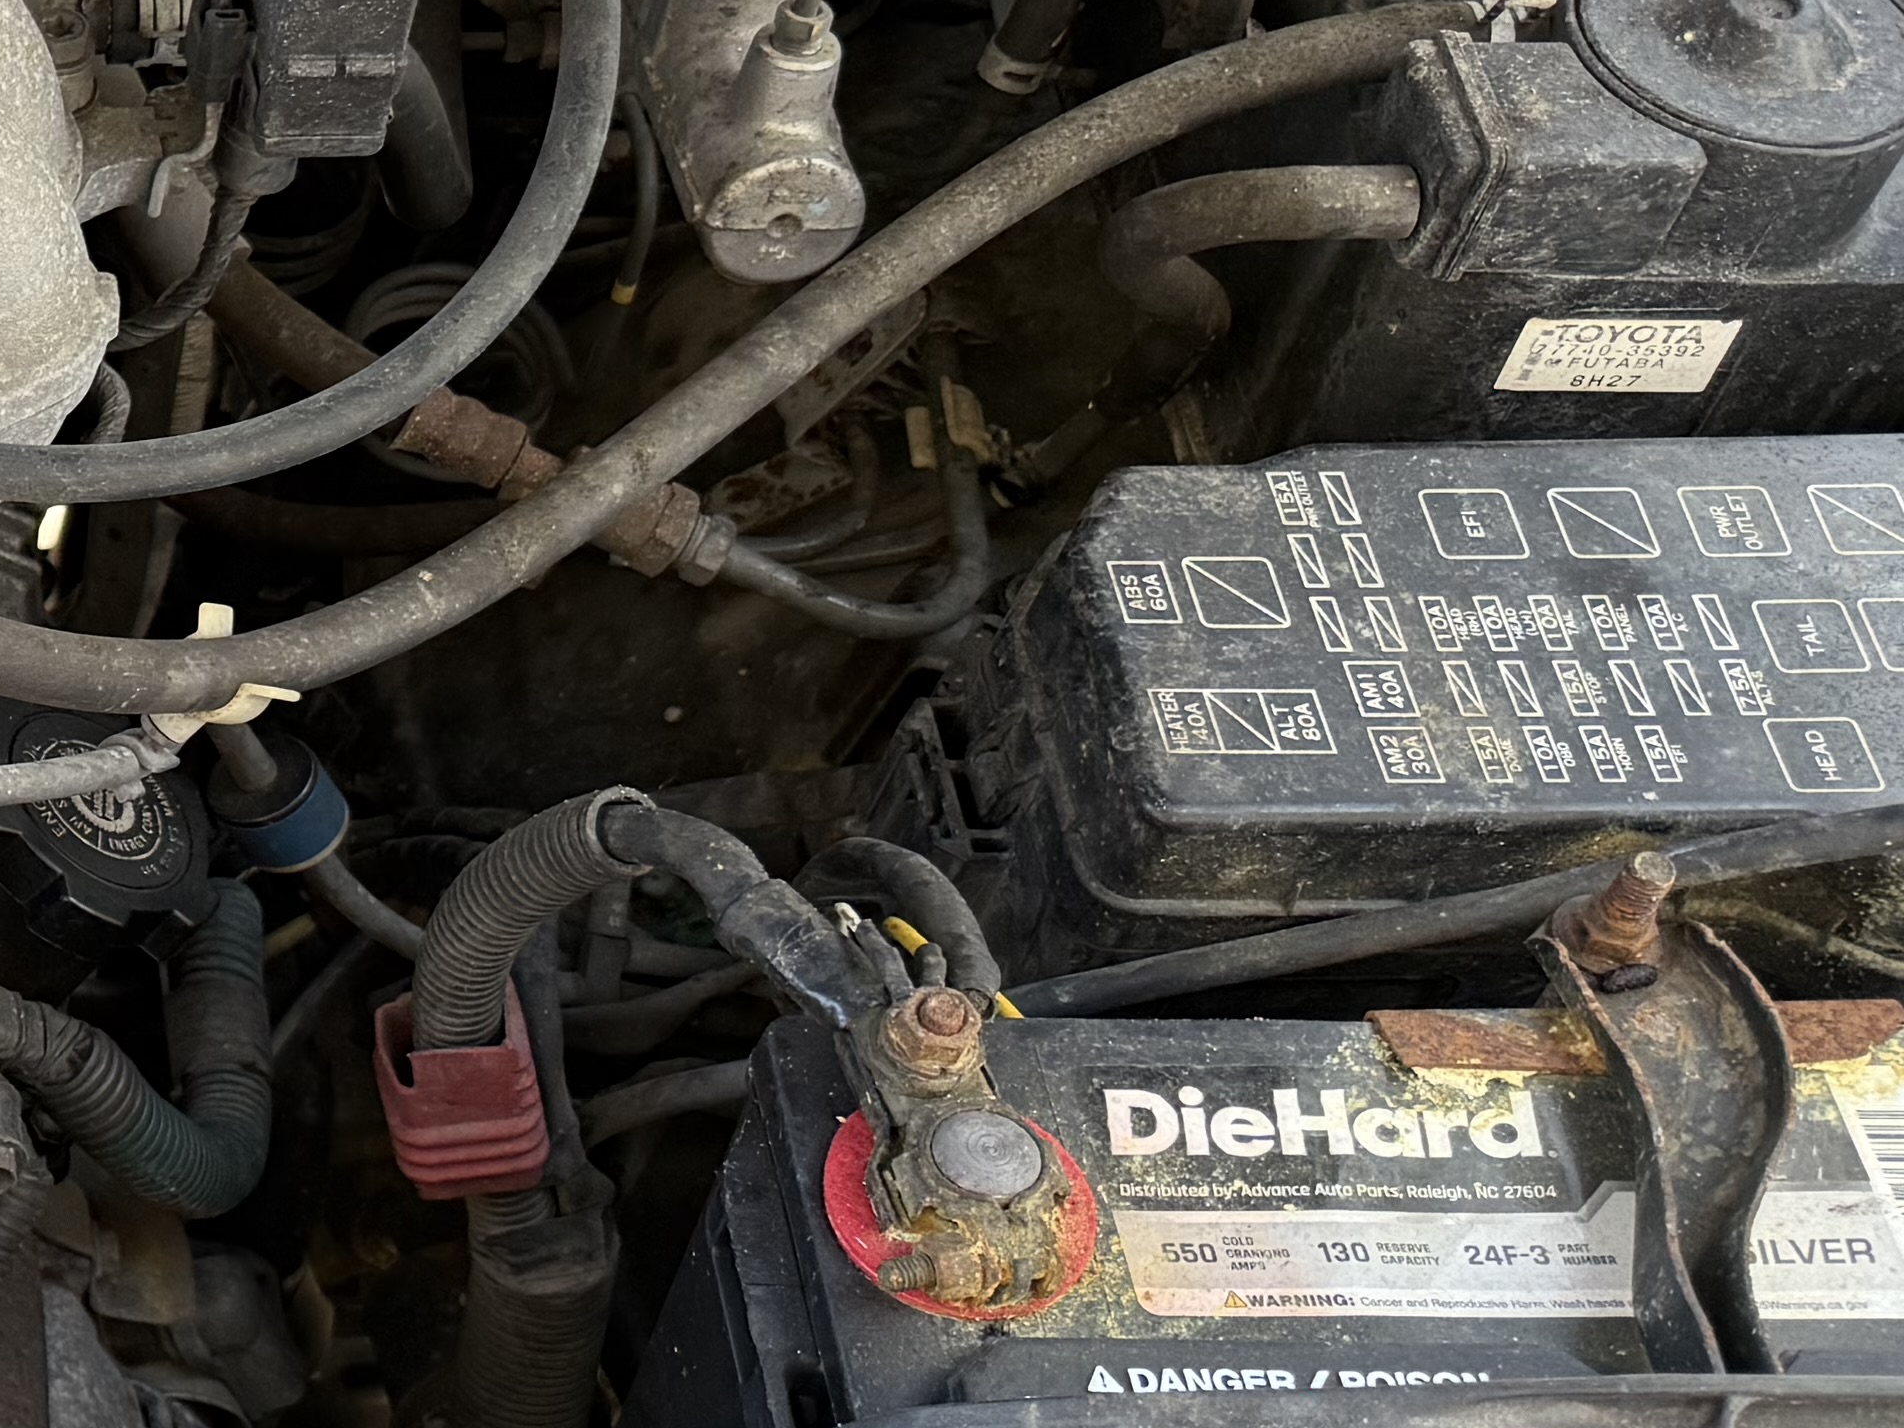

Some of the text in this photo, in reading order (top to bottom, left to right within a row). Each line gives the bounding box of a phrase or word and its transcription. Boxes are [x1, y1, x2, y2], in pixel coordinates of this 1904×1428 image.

[1554, 324, 1703, 345] TOYOTA
[1567, 357, 1664, 369] FUTABA
[1274, 481, 1298, 514] 15A
[1460, 511, 1486, 538] EFI
[1710, 506, 1737, 538] PWR
[1725, 493, 1764, 551] OUTLET
[1120, 574, 1147, 611] ABS
[1142, 574, 1168, 611] 60A
[1428, 605, 1452, 641] 10A
[1450, 608, 1470, 641] HEAD
[1482, 604, 1507, 640] 10A
[1505, 607, 1526, 640] HEAD
[1538, 604, 1562, 640] 10A
[1562, 609, 1580, 635] TAIL
[1593, 603, 1617, 640] 10A
[1615, 604, 1638, 642] PANEL
[1648, 603, 1672, 638] 10A
[1796, 614, 1825, 657] TAIL
[1357, 673, 1385, 710] AM1
[1378, 670, 1405, 709] 40A
[1562, 669, 1587, 705] 15A
[1585, 673, 1607, 704] STOP
[1728, 666, 1757, 709] 7.5A
[1157, 691, 1188, 752] HEATER
[1187, 703, 1209, 742] 40A
[1270, 703, 1299, 740] ALT
[1294, 703, 1321, 741] 80A
[1380, 735, 1409, 775] AM2
[1403, 736, 1431, 774] 30A
[1476, 735, 1499, 772] 15A
[1532, 734, 1557, 772] 10A
[1588, 734, 1614, 771] 15A
[1611, 737, 1634, 771] HORN
[1644, 735, 1671, 771] 15A
[1670, 744, 1688, 764] EFI
[1805, 730, 1842, 781] HEAD
[1103, 1086, 1544, 1159] DieHard
[1120, 1183, 1209, 1198] Distributed
[1241, 1182, 1310, 1198] Advance
[1314, 1183, 1353, 1198] Auto
[1357, 1183, 1404, 1200] Parts,
[1406, 1183, 1472, 1202] Raleigh,
[1476, 1183, 1500, 1199] NC
[1504, 1184, 1558, 1199] 27604
[1161, 1242, 1370, 1264] 550 130
[1222, 1236, 1254, 1247] COLD
[1225, 1248, 1291, 1260] CRANKING
[1376, 1242, 1431, 1254] RESERVE
[1464, 1244, 1552, 1266] 24F-3
[1557, 1243, 1592, 1254] PART
[1230, 1260, 1266, 1271] AMPS
[1380, 1255, 1441, 1266] CAPACITY
[1563, 1255, 1618, 1266] NUMBER
[1246, 1294, 1355, 1308] WARNING:
[1360, 1296, 1403, 1308] Cancer
[1406, 1297, 1429, 1308] and
[1549, 1299, 1585, 1309] Wash
[1587, 1299, 1626, 1310] hands
[1128, 1367, 1296, 1394] DANGER
